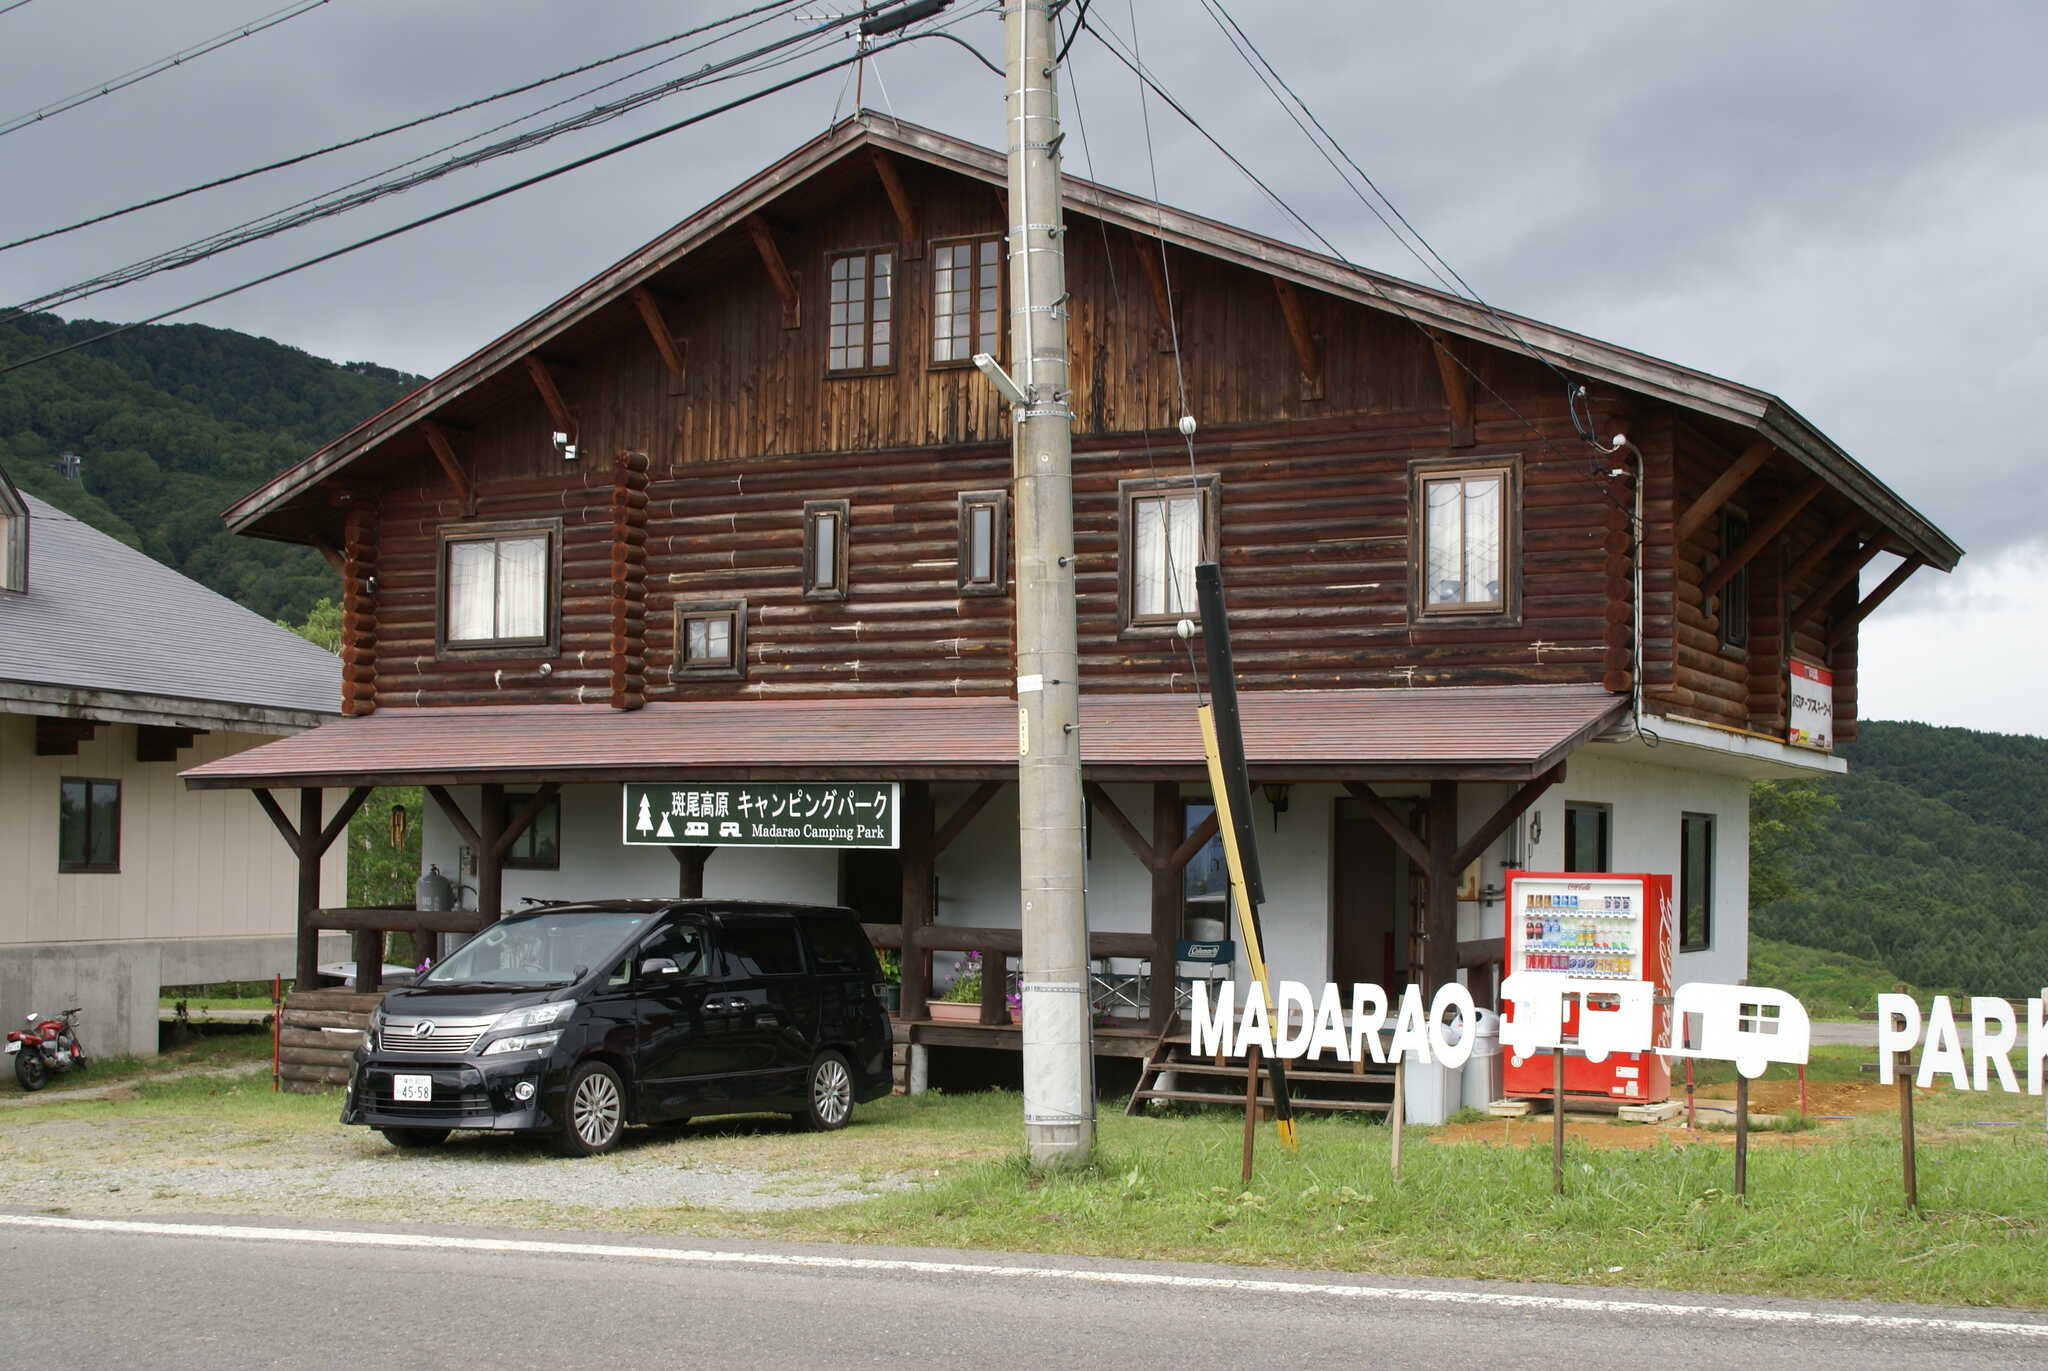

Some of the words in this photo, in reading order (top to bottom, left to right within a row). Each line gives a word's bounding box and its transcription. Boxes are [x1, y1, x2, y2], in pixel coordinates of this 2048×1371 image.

[671, 790, 729, 818] 斑尾高原
[737, 788, 888, 820] キャンピングパーク
[752, 823, 801, 838] Madarao
[803, 824, 854, 841] Camping
[857, 825, 885, 839] Park
[1190, 980, 1476, 1069] MADARAO
